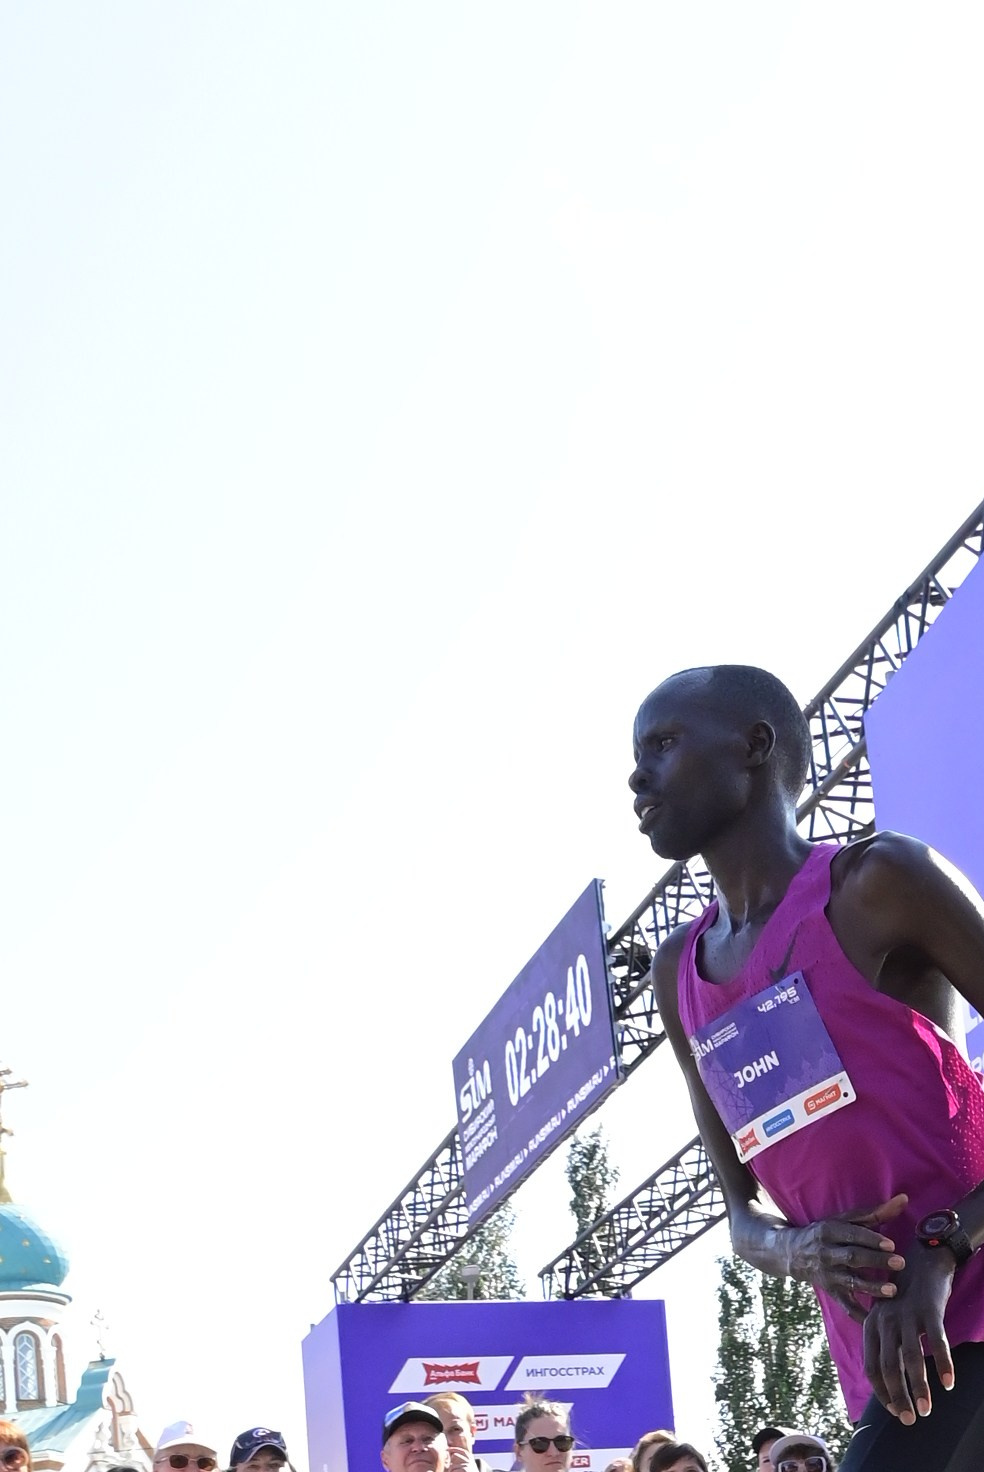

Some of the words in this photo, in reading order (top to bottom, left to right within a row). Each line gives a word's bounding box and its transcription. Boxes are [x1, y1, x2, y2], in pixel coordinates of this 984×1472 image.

[505, 954, 592, 1106] 02:28:40
[733, 1050, 780, 1089] JOHN
[526, 1366, 605, 1378] ИНГОССТРАХ
